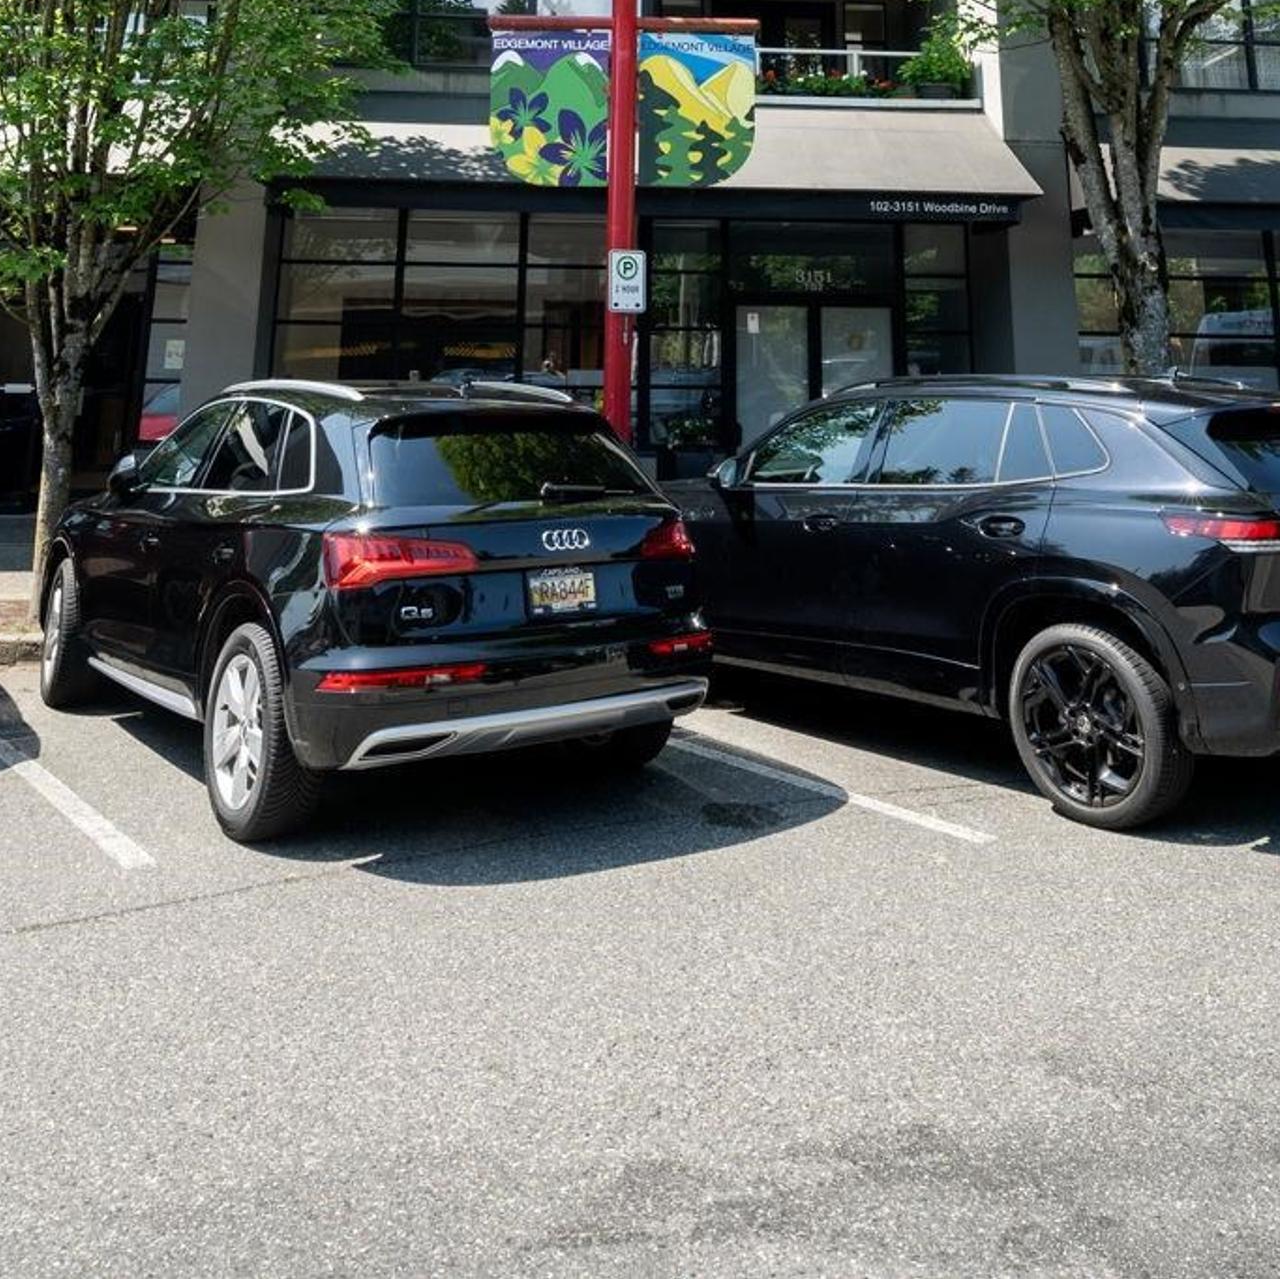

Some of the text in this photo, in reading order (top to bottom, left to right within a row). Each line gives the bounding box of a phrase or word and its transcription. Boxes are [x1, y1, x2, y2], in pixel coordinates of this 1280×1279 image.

[494, 38, 610, 51] EDGEMONT VILLAGE
[641, 41, 754, 54] EDGEMONT VILLAGE
[869, 200, 1009, 214] 102-3151 Woodbine Drive
